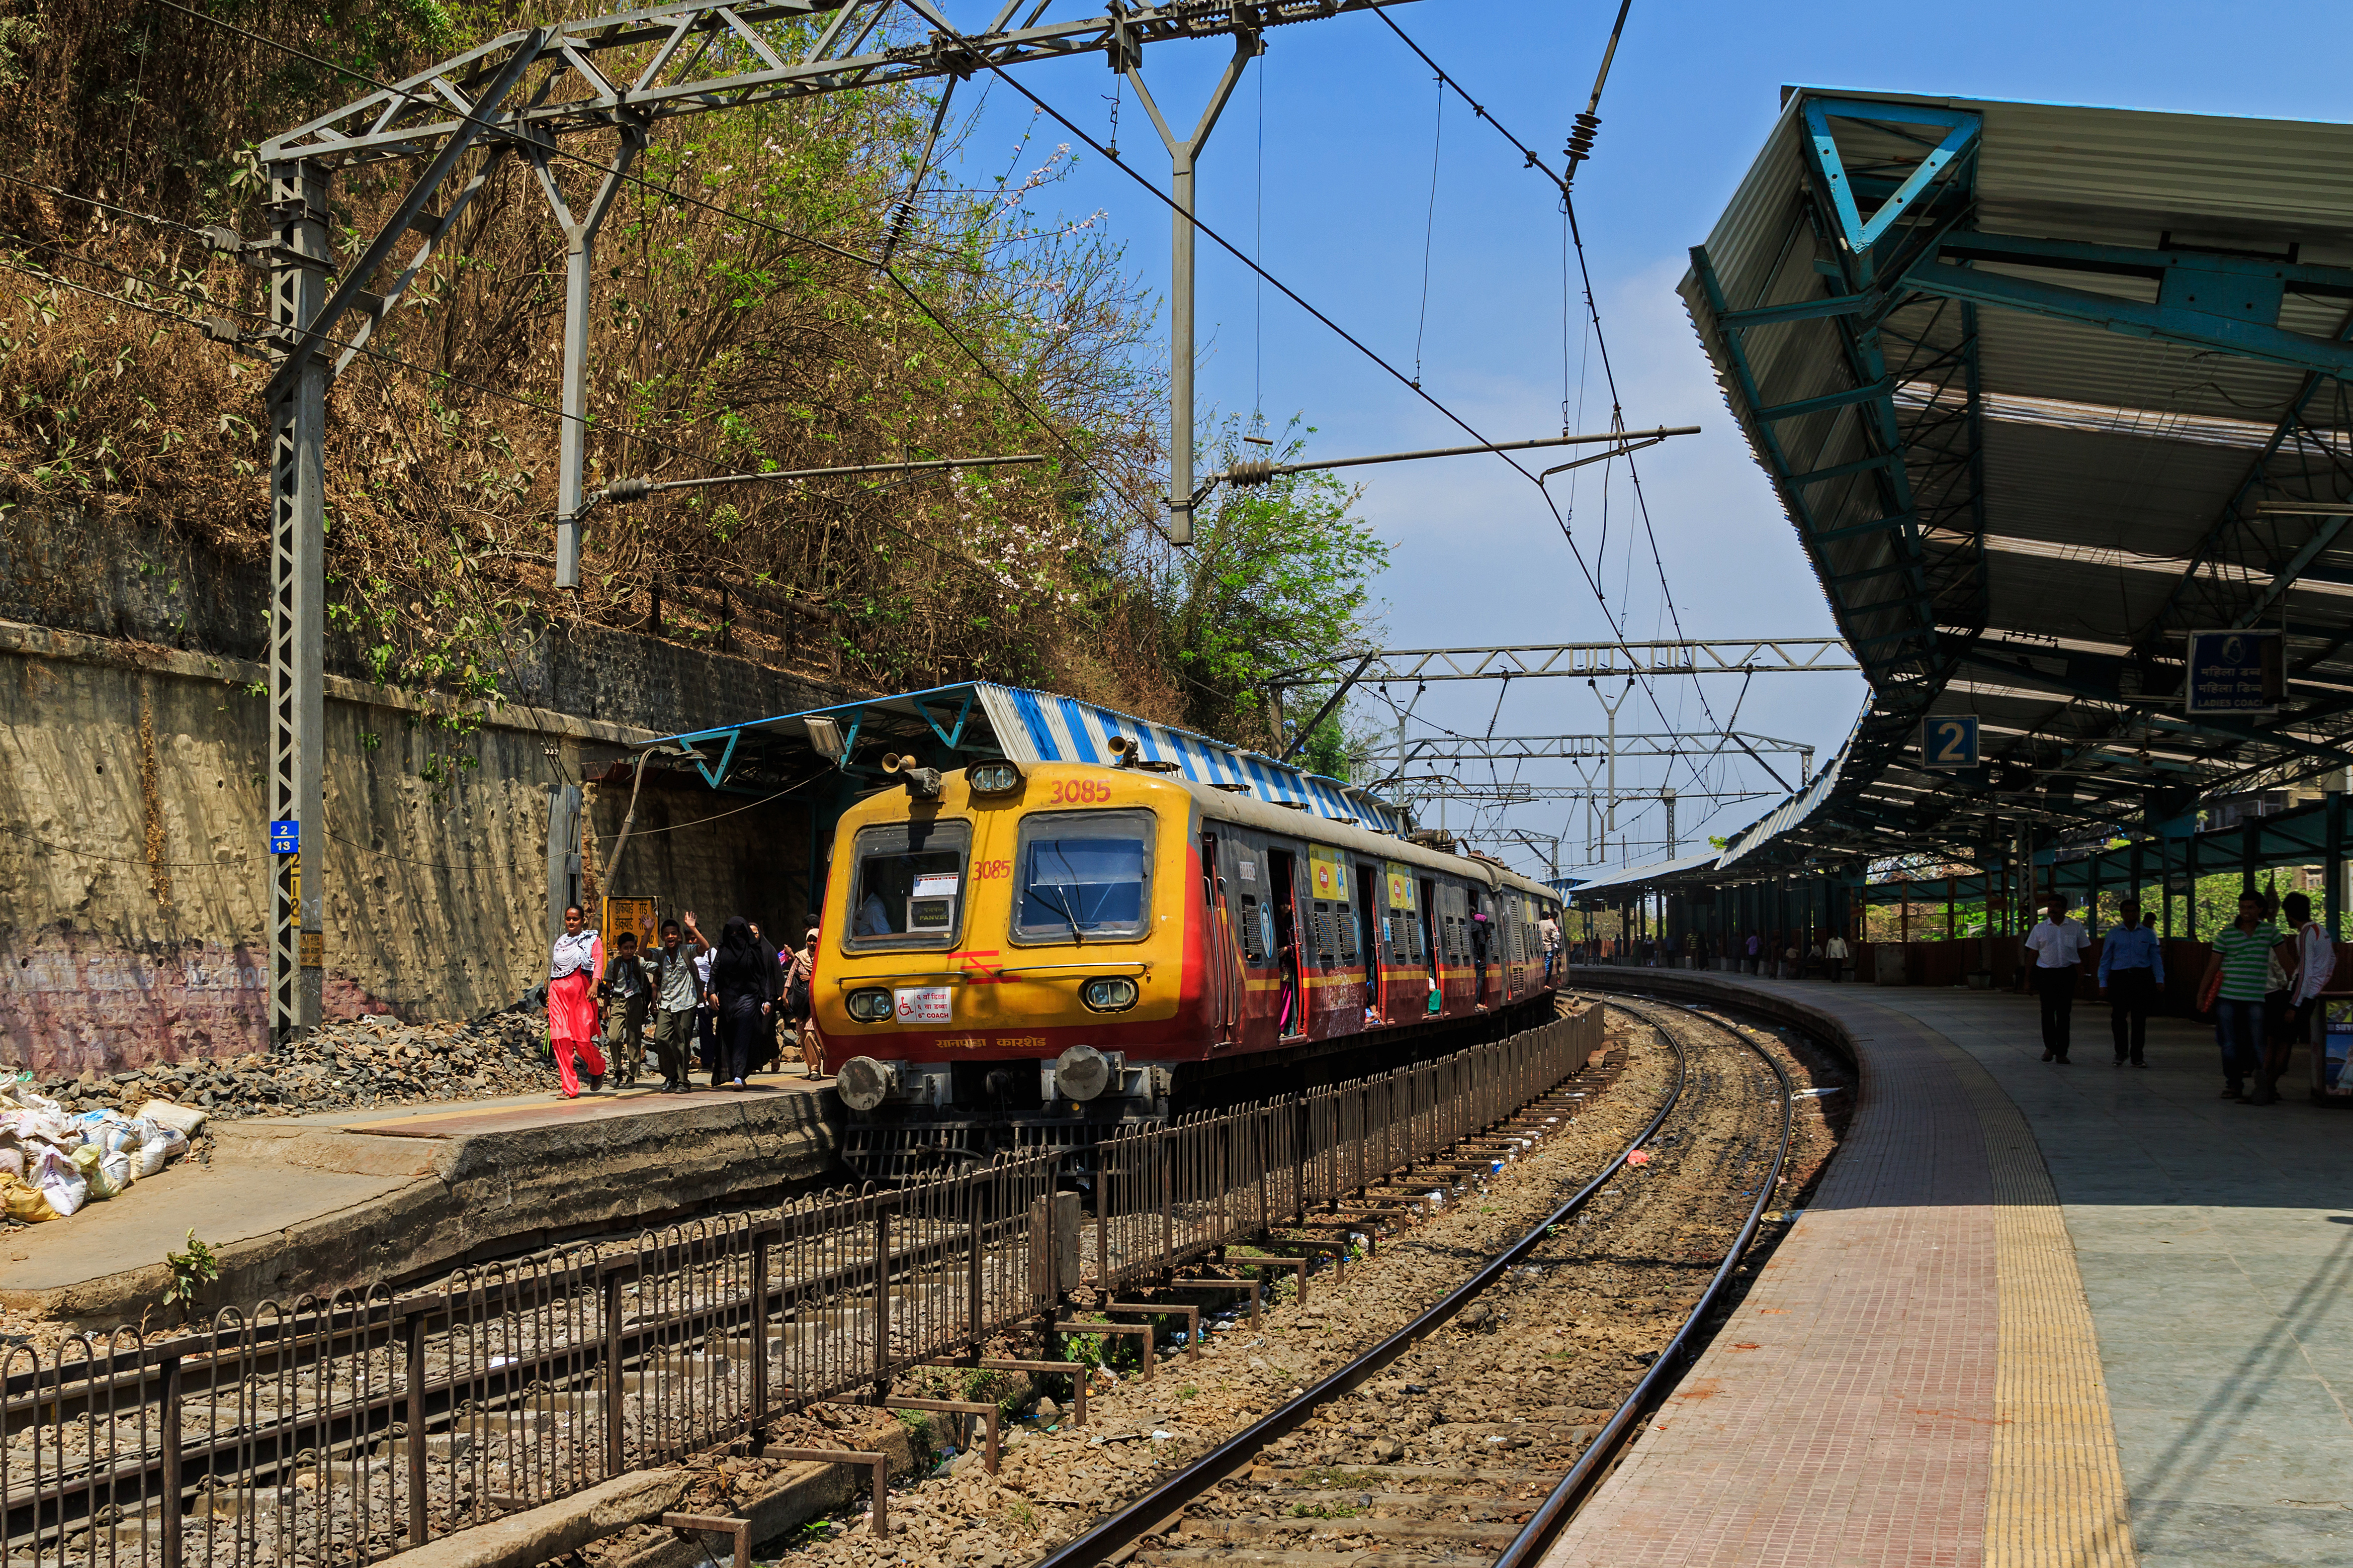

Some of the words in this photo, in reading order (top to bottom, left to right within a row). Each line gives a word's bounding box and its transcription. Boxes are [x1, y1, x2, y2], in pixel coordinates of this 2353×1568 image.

[2201, 665, 2236, 677] महिला
[2198, 681, 2233, 693] महिला
[1937, 722, 1965, 761] 2
[1050, 779, 1111, 804] 3085
[280, 825, 288, 835] 2
[291, 852, 300, 868] 2
[973, 860, 1012, 881] 3085
[639, 899, 648, 914] रोड
[935, 1038, 987, 1048] सानपाडा
[996, 1036, 1046, 1047] कारशेड
